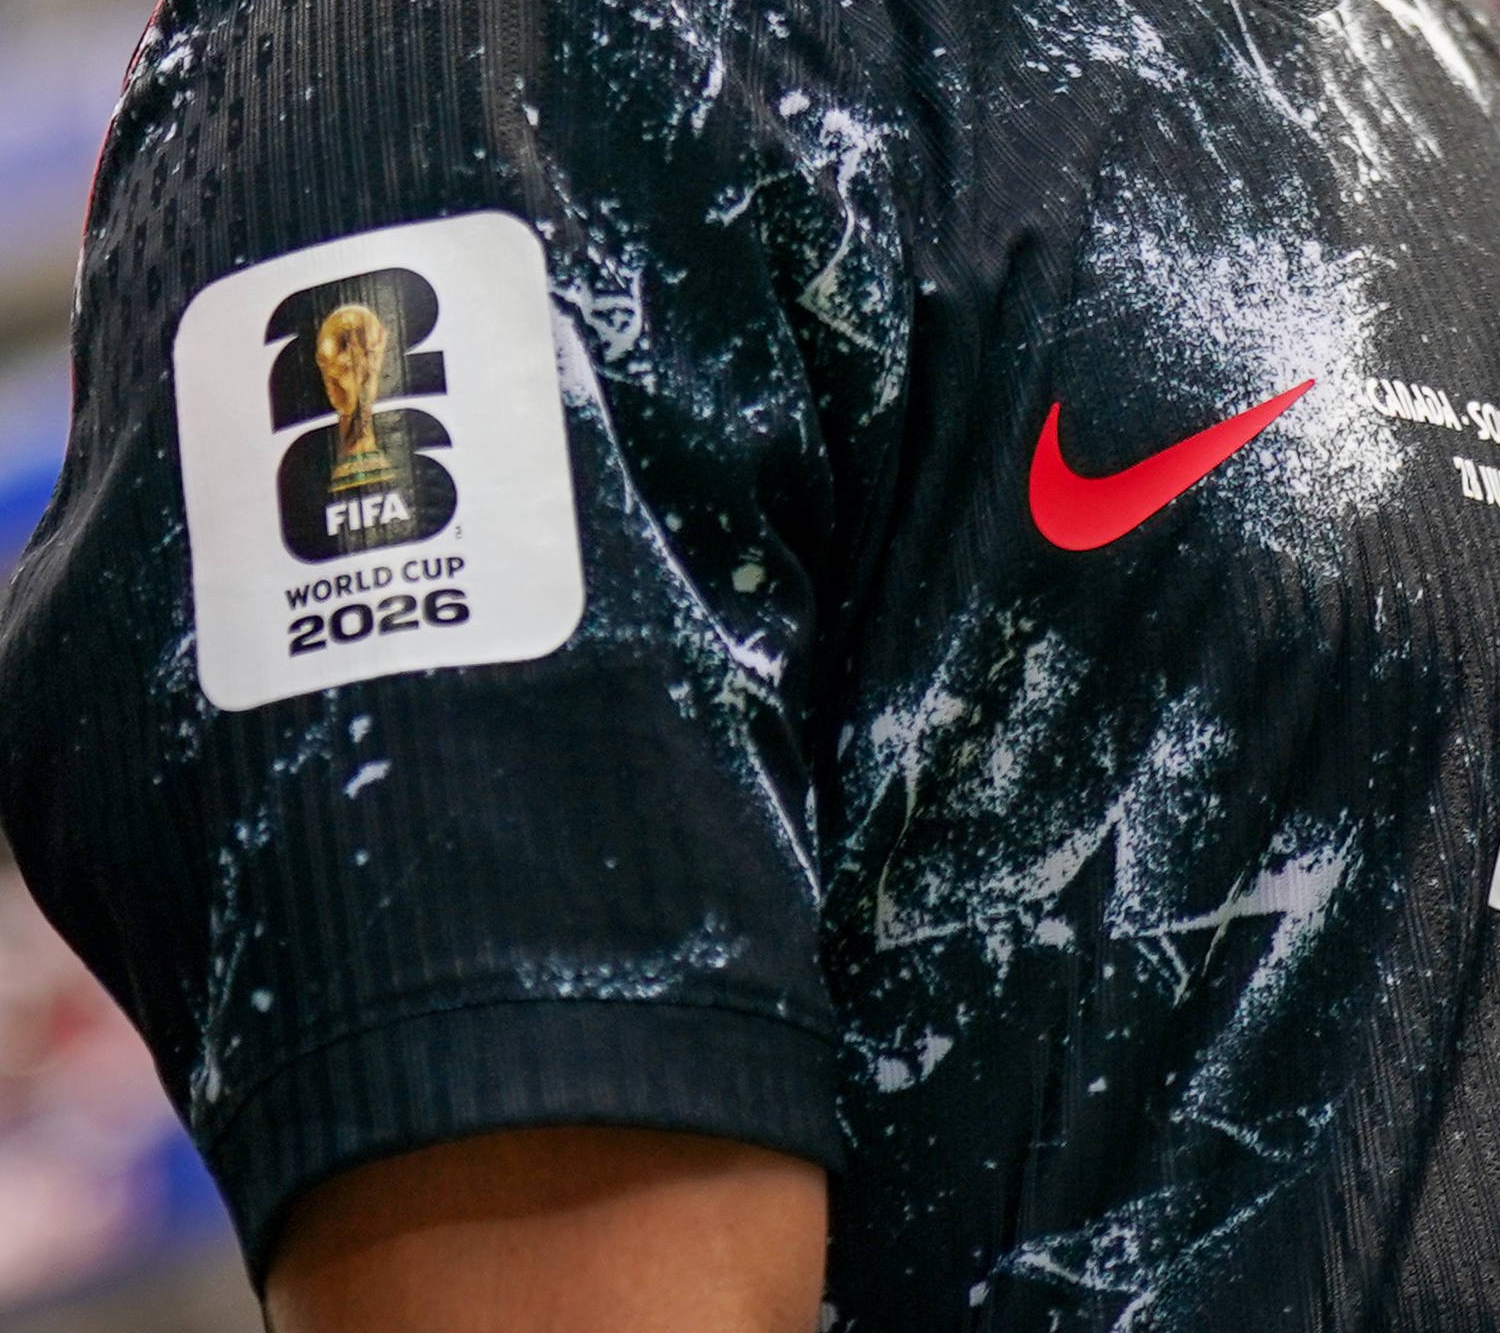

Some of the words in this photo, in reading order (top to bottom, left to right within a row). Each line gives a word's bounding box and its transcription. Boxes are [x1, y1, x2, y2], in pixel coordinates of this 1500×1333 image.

[325, 493, 410, 537] FIFA
[285, 566, 393, 611] WORLD
[401, 556, 465, 583] CUP
[287, 588, 471, 658] 2026
